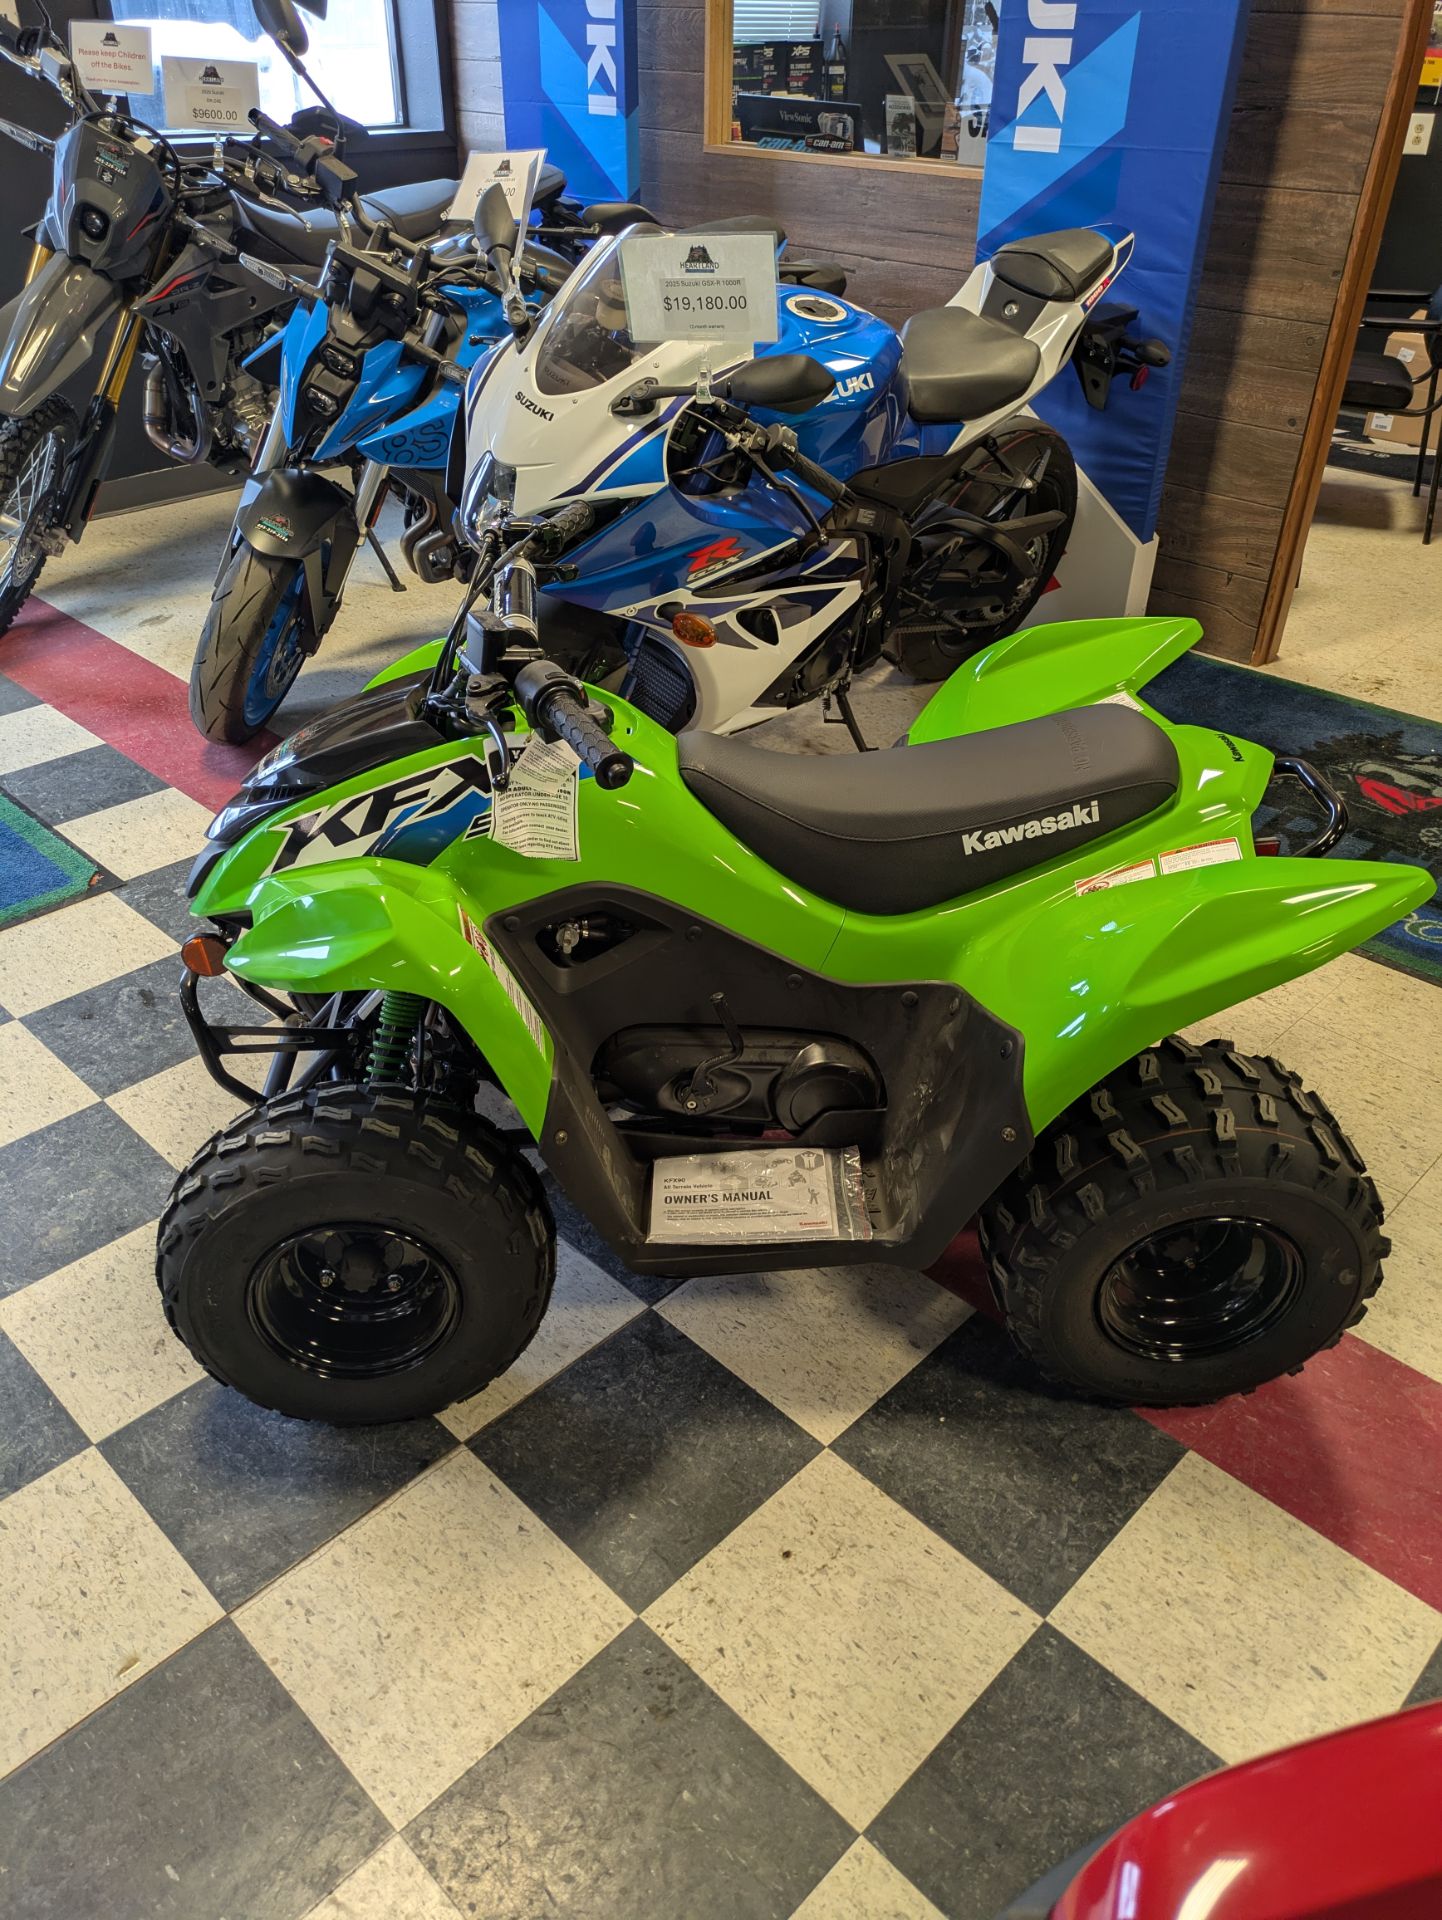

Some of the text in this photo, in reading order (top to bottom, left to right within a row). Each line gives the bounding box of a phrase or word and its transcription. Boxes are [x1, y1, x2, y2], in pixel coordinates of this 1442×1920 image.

[79, 48, 146, 60] Please keep Children
[192, 108, 237, 120] $9600.00
[779, 110, 813, 123] ViewSonic
[813, 140, 844, 149] can-am
[663, 296, 747, 312] $19,180.00
[514, 391, 555, 422] SUZUKI
[506, 791, 531, 799] OPERATOR
[961, 800, 1100, 856] Kawasaki
[664, 1191, 773, 1205] OWNER'S MANUAL
